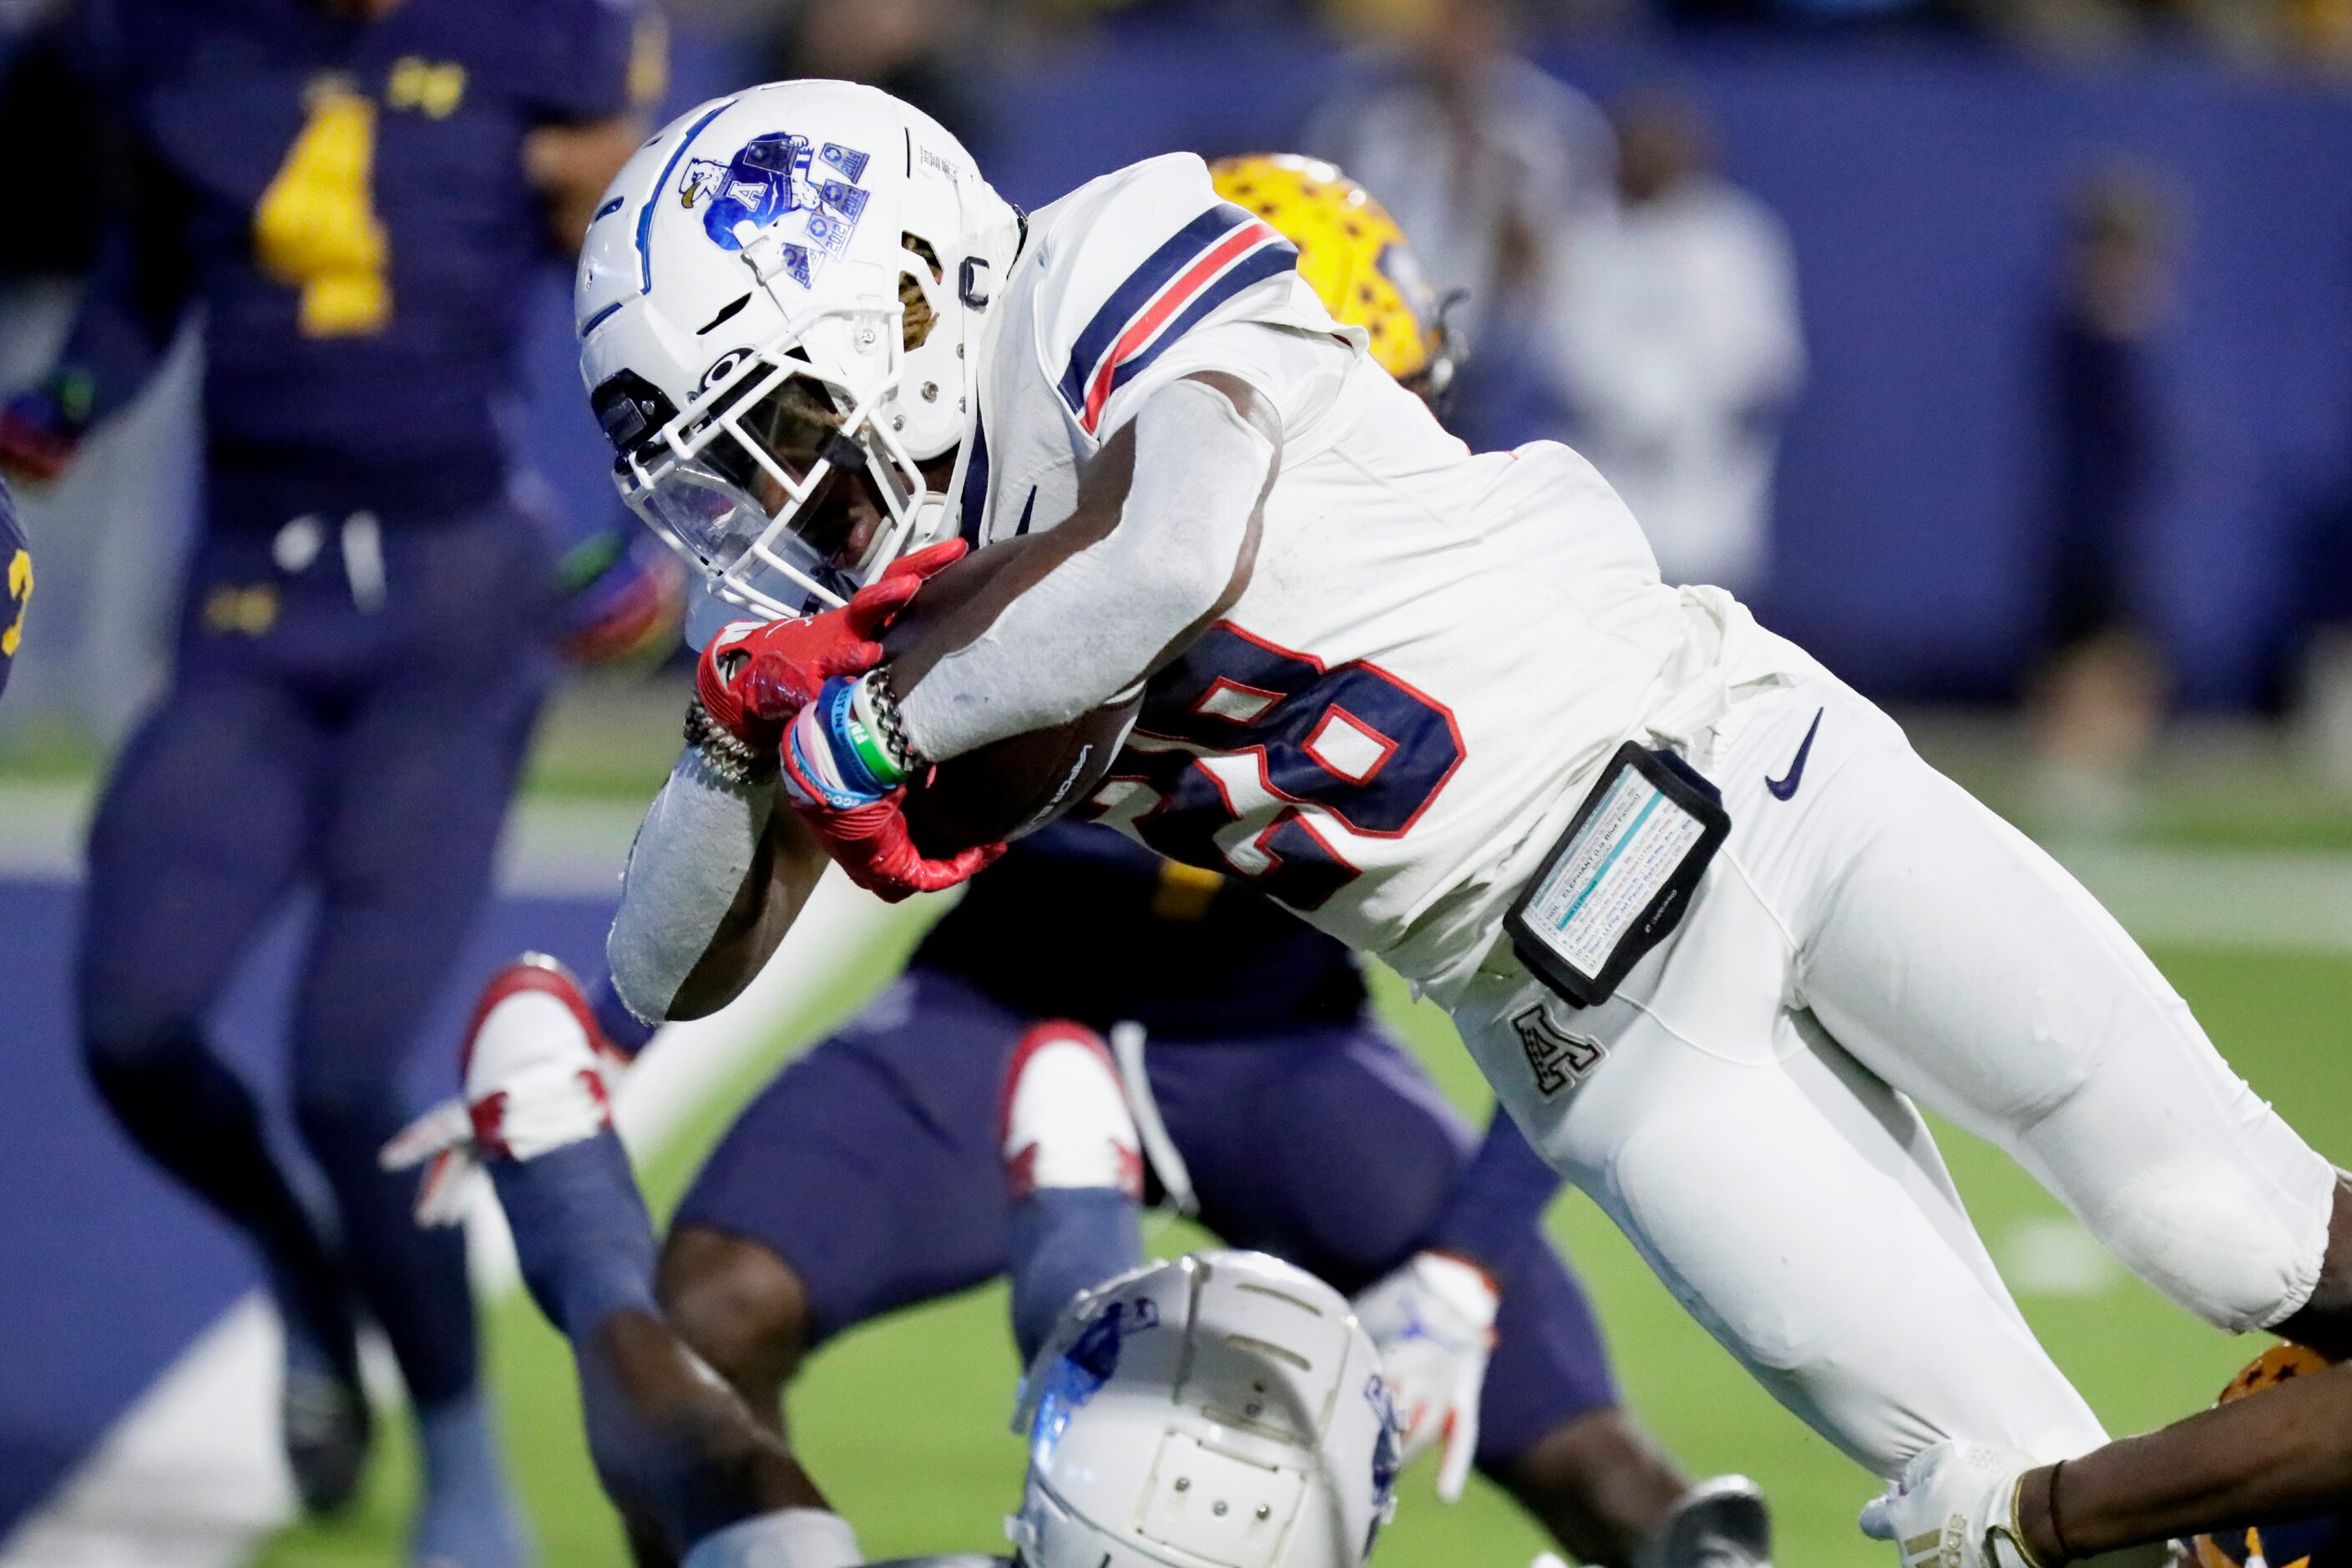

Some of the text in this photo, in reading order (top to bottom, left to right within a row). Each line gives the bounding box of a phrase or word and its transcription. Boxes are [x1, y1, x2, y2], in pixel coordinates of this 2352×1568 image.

[842, 151, 861, 175] 2014
[253, 88, 392, 340] 4
[726, 180, 768, 212] A
[842, 188, 861, 215] 2013
[826, 223, 847, 252] 2012
[1050, 744, 1094, 803] VAPOR
[1560, 856, 1594, 898] ELEPHANT
[1603, 821, 1619, 841] Blue
[1616, 792, 1641, 823] Falcon)
[1510, 1000, 1605, 1098] A
